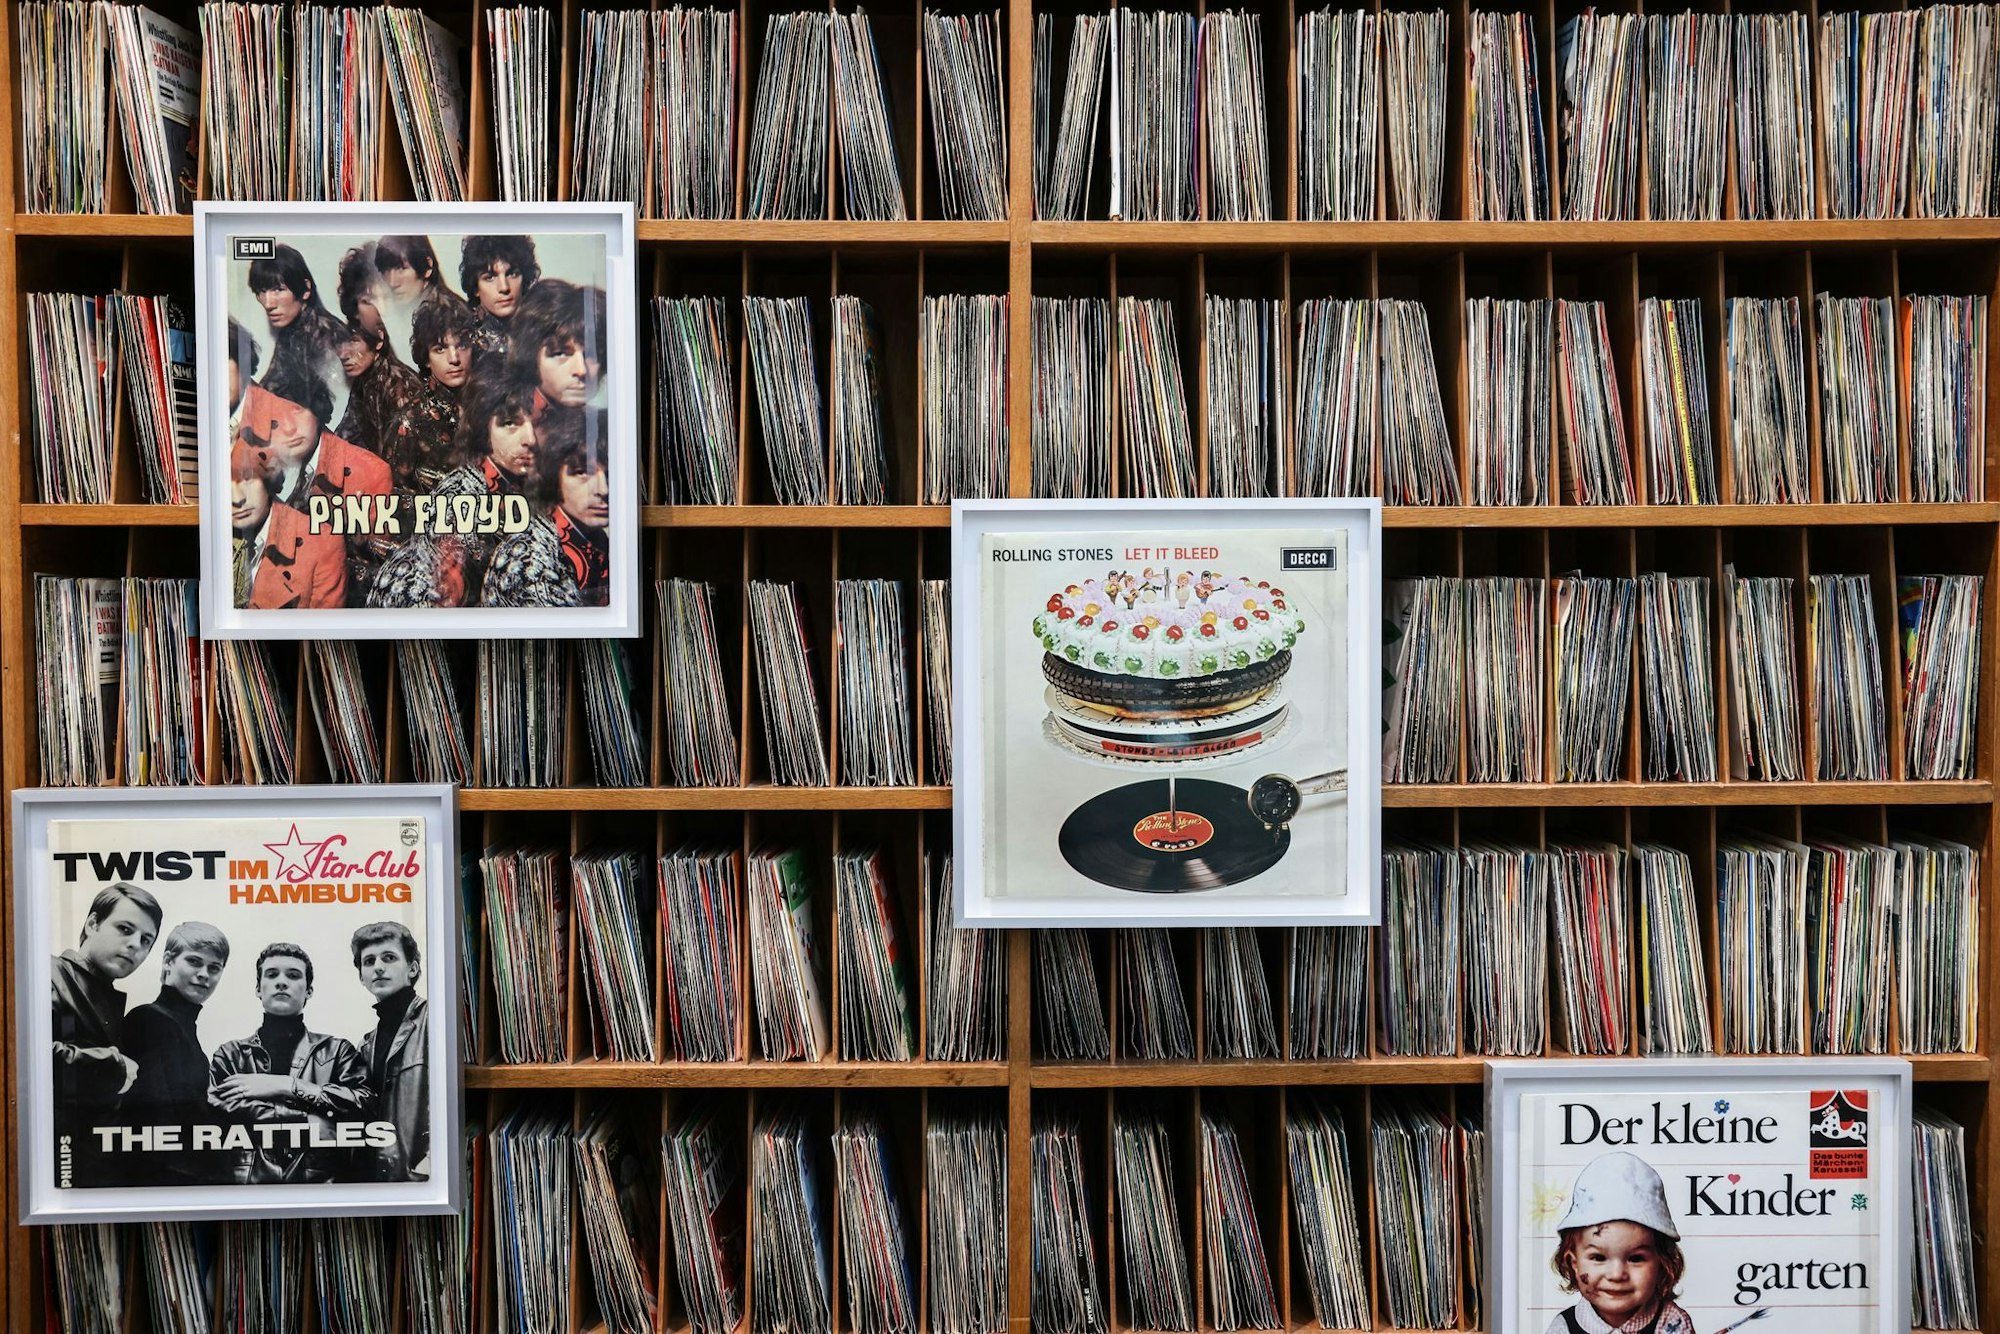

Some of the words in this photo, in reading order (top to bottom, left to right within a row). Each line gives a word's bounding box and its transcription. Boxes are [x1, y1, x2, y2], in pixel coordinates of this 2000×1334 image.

[241, 243, 269, 253] EMI
[414, 494, 531, 535] FLOYD
[992, 549, 1051, 562] ROLLING
[1058, 548, 1113, 561] STONES
[1125, 548, 1150, 561] LET
[1156, 548, 1169, 560] IT
[1174, 547, 1219, 560] BLEED
[1290, 552, 1328, 566] DECCA
[1137, 819, 1173, 832] Rolling
[53, 850, 226, 882] TWIST
[229, 860, 269, 880] IM
[229, 882, 412, 905] HAMBURG
[92, 1125, 183, 1153] THE
[193, 1121, 397, 1150] RATTLES
[1559, 1103, 1643, 1145] Der
[1650, 1101, 1778, 1144] kleine
[60, 1135, 72, 1188] PHILIPS
[1813, 1166, 1863, 1174] Karussell
[1684, 1173, 1836, 1217] Kinder
[1733, 1259, 1869, 1306] garten
